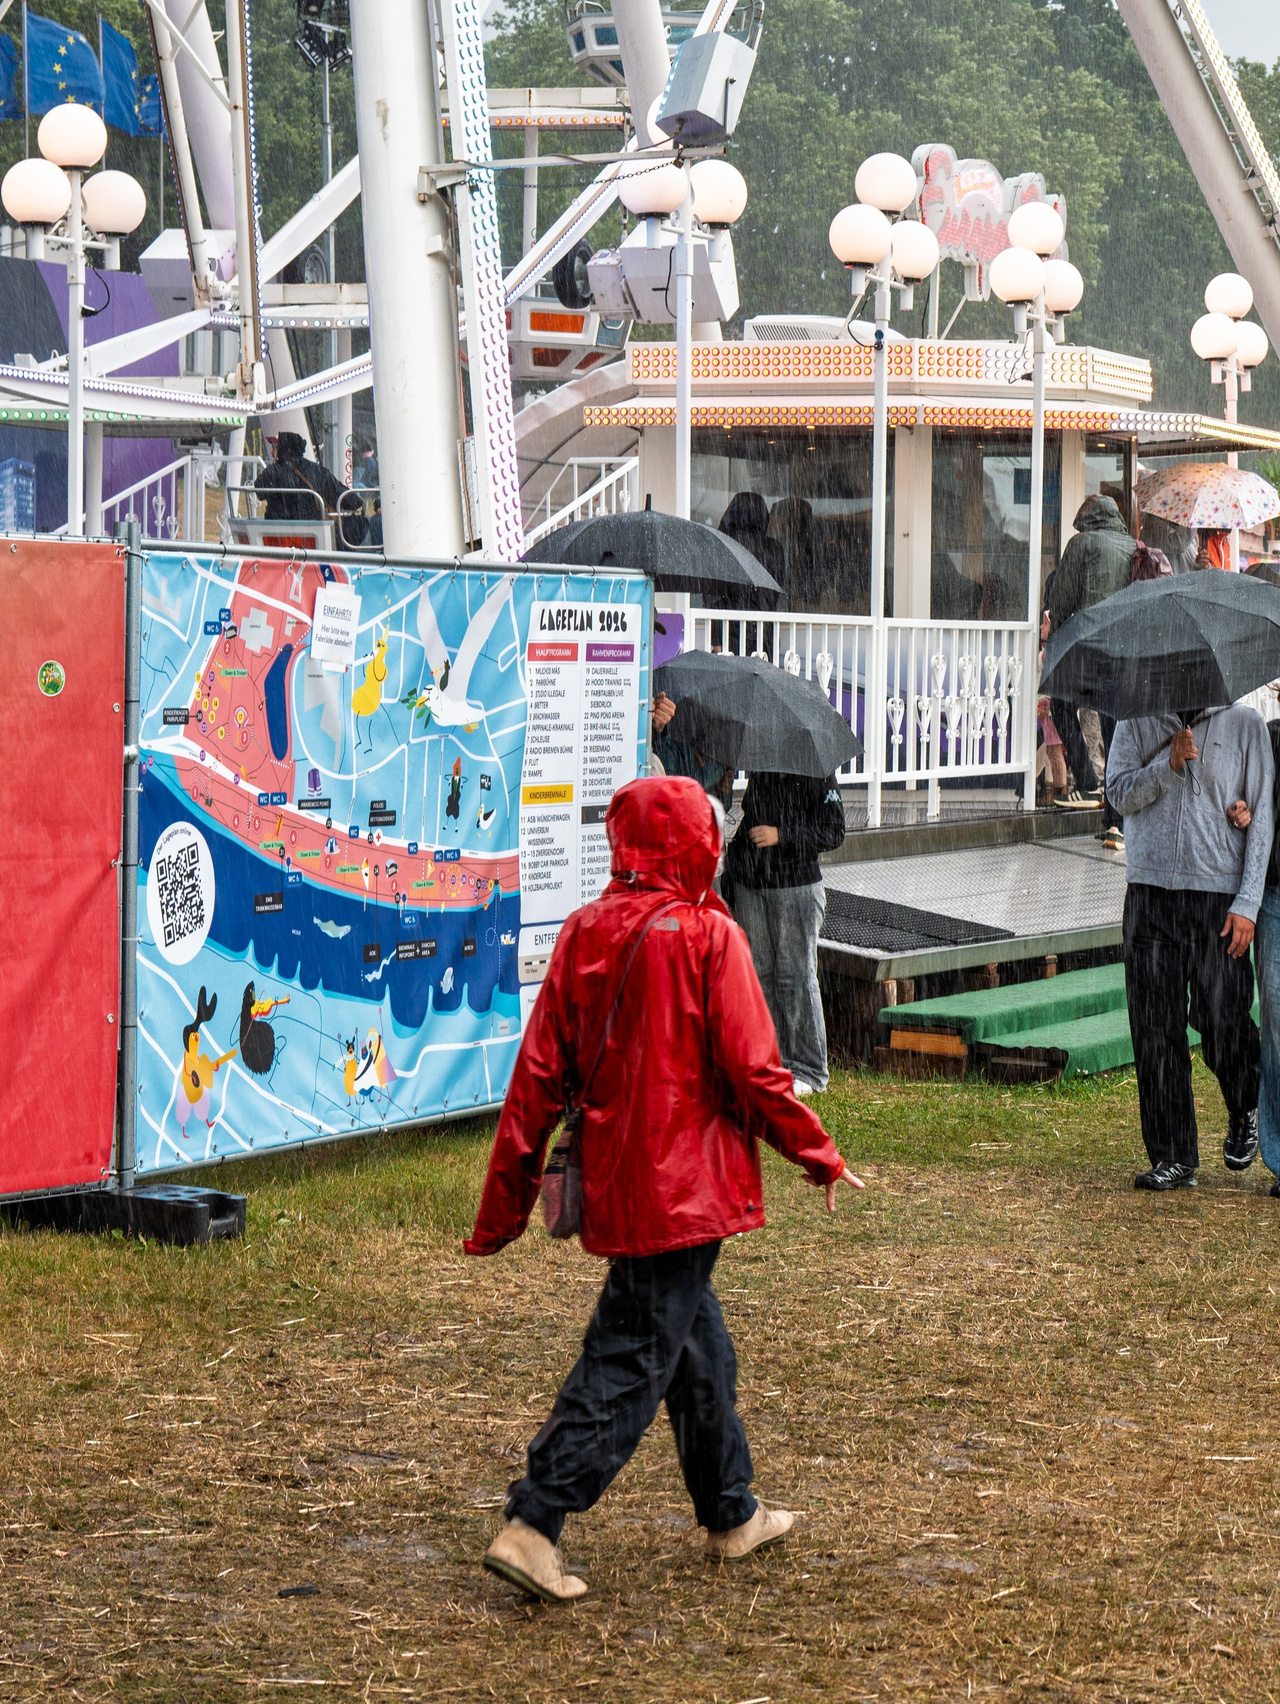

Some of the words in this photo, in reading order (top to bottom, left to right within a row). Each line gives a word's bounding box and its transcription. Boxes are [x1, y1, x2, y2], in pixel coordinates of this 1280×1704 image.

[540, 608, 593, 631] LAGEPLAN
[599, 610, 627, 632] 2026
[550, 858, 569, 867] PARKOUR
[587, 855, 609, 864] AWARENESS
